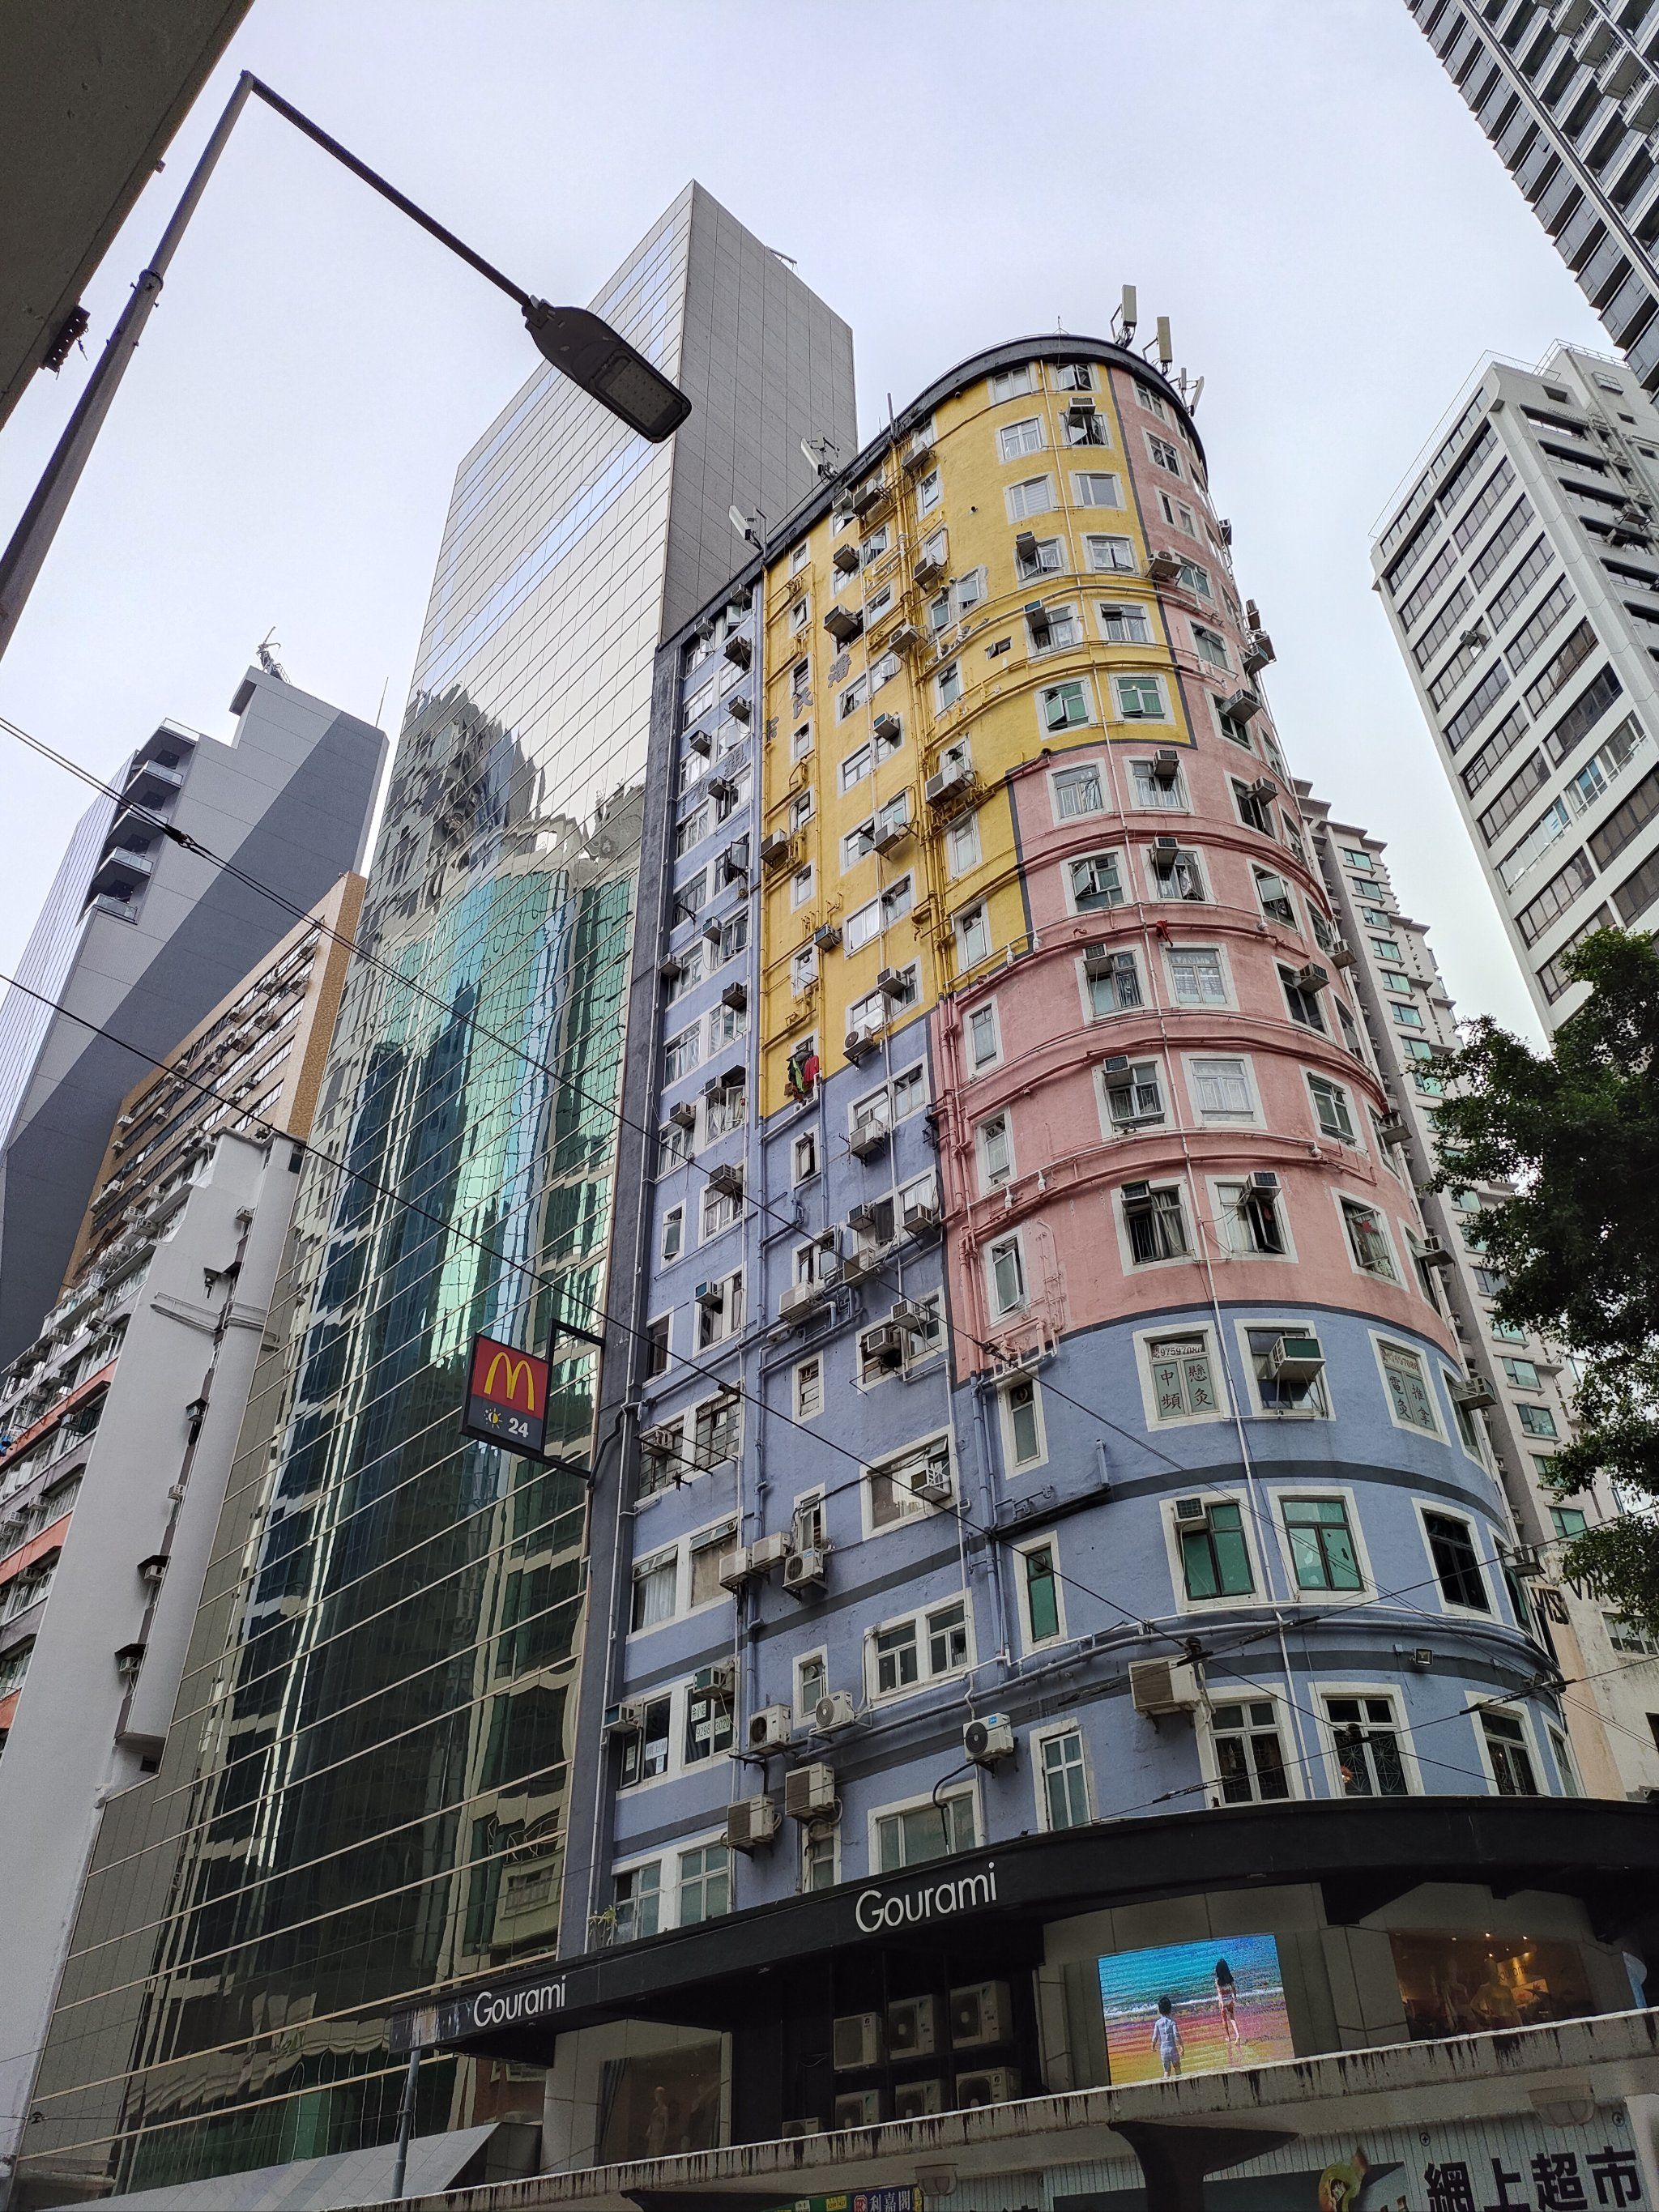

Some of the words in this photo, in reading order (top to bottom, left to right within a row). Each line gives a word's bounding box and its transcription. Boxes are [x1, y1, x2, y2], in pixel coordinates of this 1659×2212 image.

[1160, 1369, 1182, 1410] 中頻
[1412, 1383, 1431, 1426] 推拿
[508, 1417, 529, 1438] 24
[855, 1861, 997, 1933] Gourami
[473, 1975, 566, 2027] Gourami
[869, 2189, 911, 2212] 利嘉閣
[1423, 2146, 1644, 2212] 網上超市
